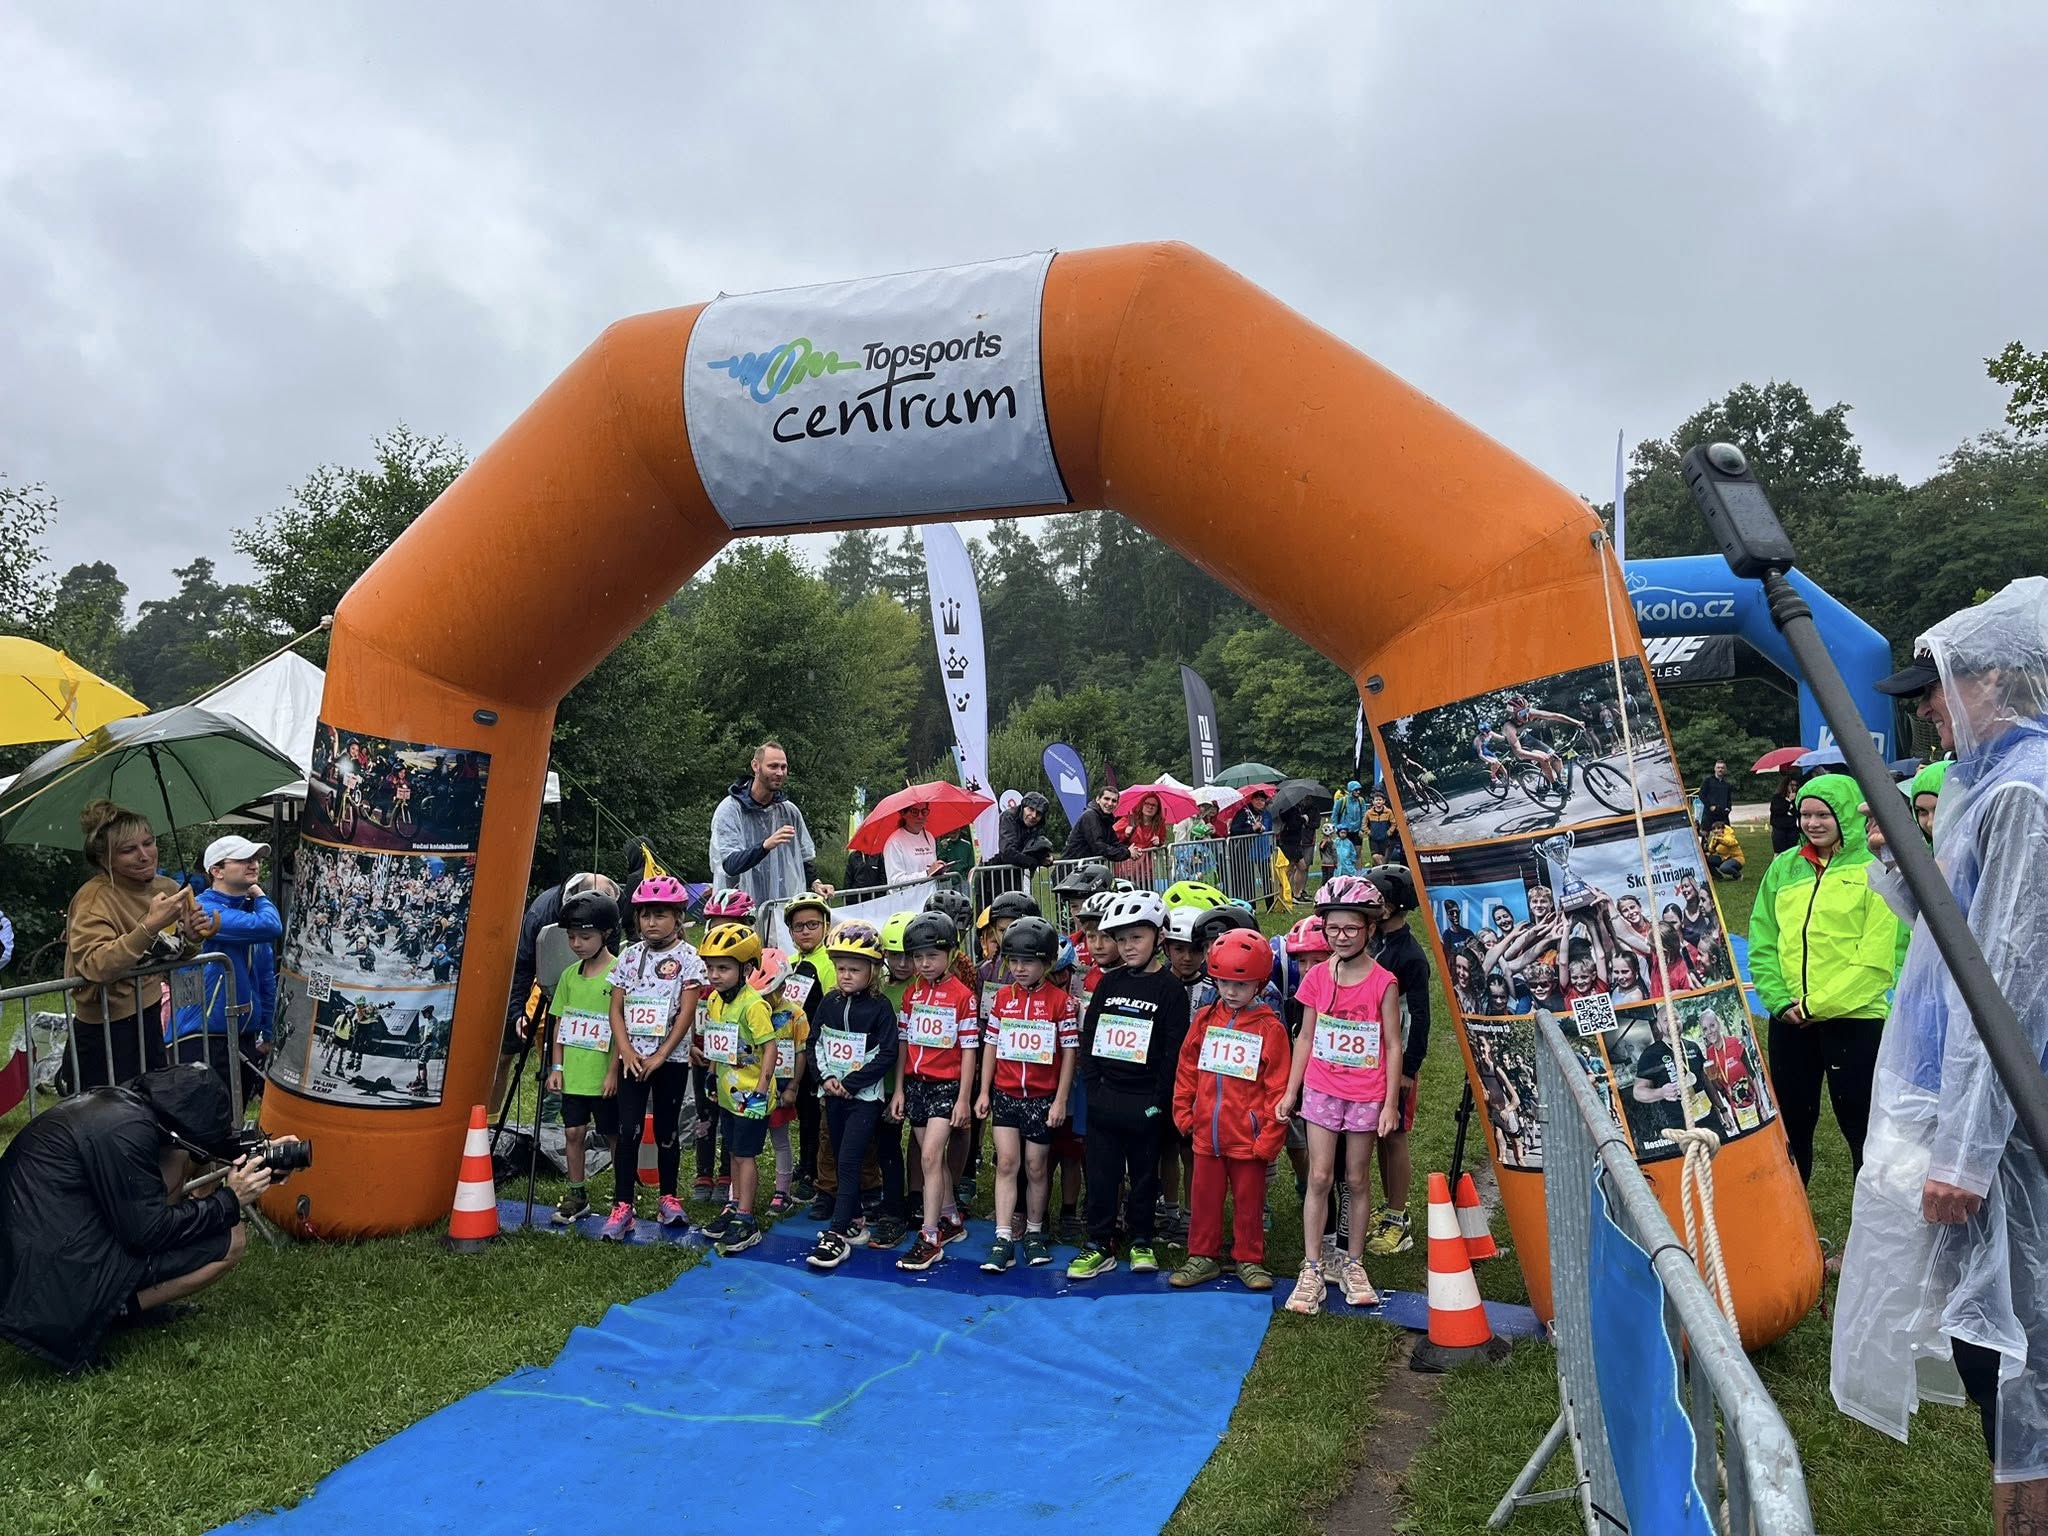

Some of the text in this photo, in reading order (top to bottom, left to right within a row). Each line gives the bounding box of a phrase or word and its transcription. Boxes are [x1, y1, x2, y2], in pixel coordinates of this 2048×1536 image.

[863, 330, 1002, 373] Topsports
[1634, 599, 1735, 622] kolo.cz
[629, 1008, 657, 1024] 125
[916, 1016, 943, 1035] 108
[571, 1020, 600, 1039] 114
[1106, 1028, 1137, 1048] 102
[707, 1034, 729, 1051] 182
[826, 1040, 853, 1060] 129
[1009, 1032, 1042, 1050] 109
[1327, 1032, 1365, 1054] 128
[1212, 1041, 1246, 1064] 113
[311, 1085, 333, 1094] KEMP
[313, 1079, 338, 1089] IN-LINE
[1643, 1138, 1676, 1150] Hostiva
